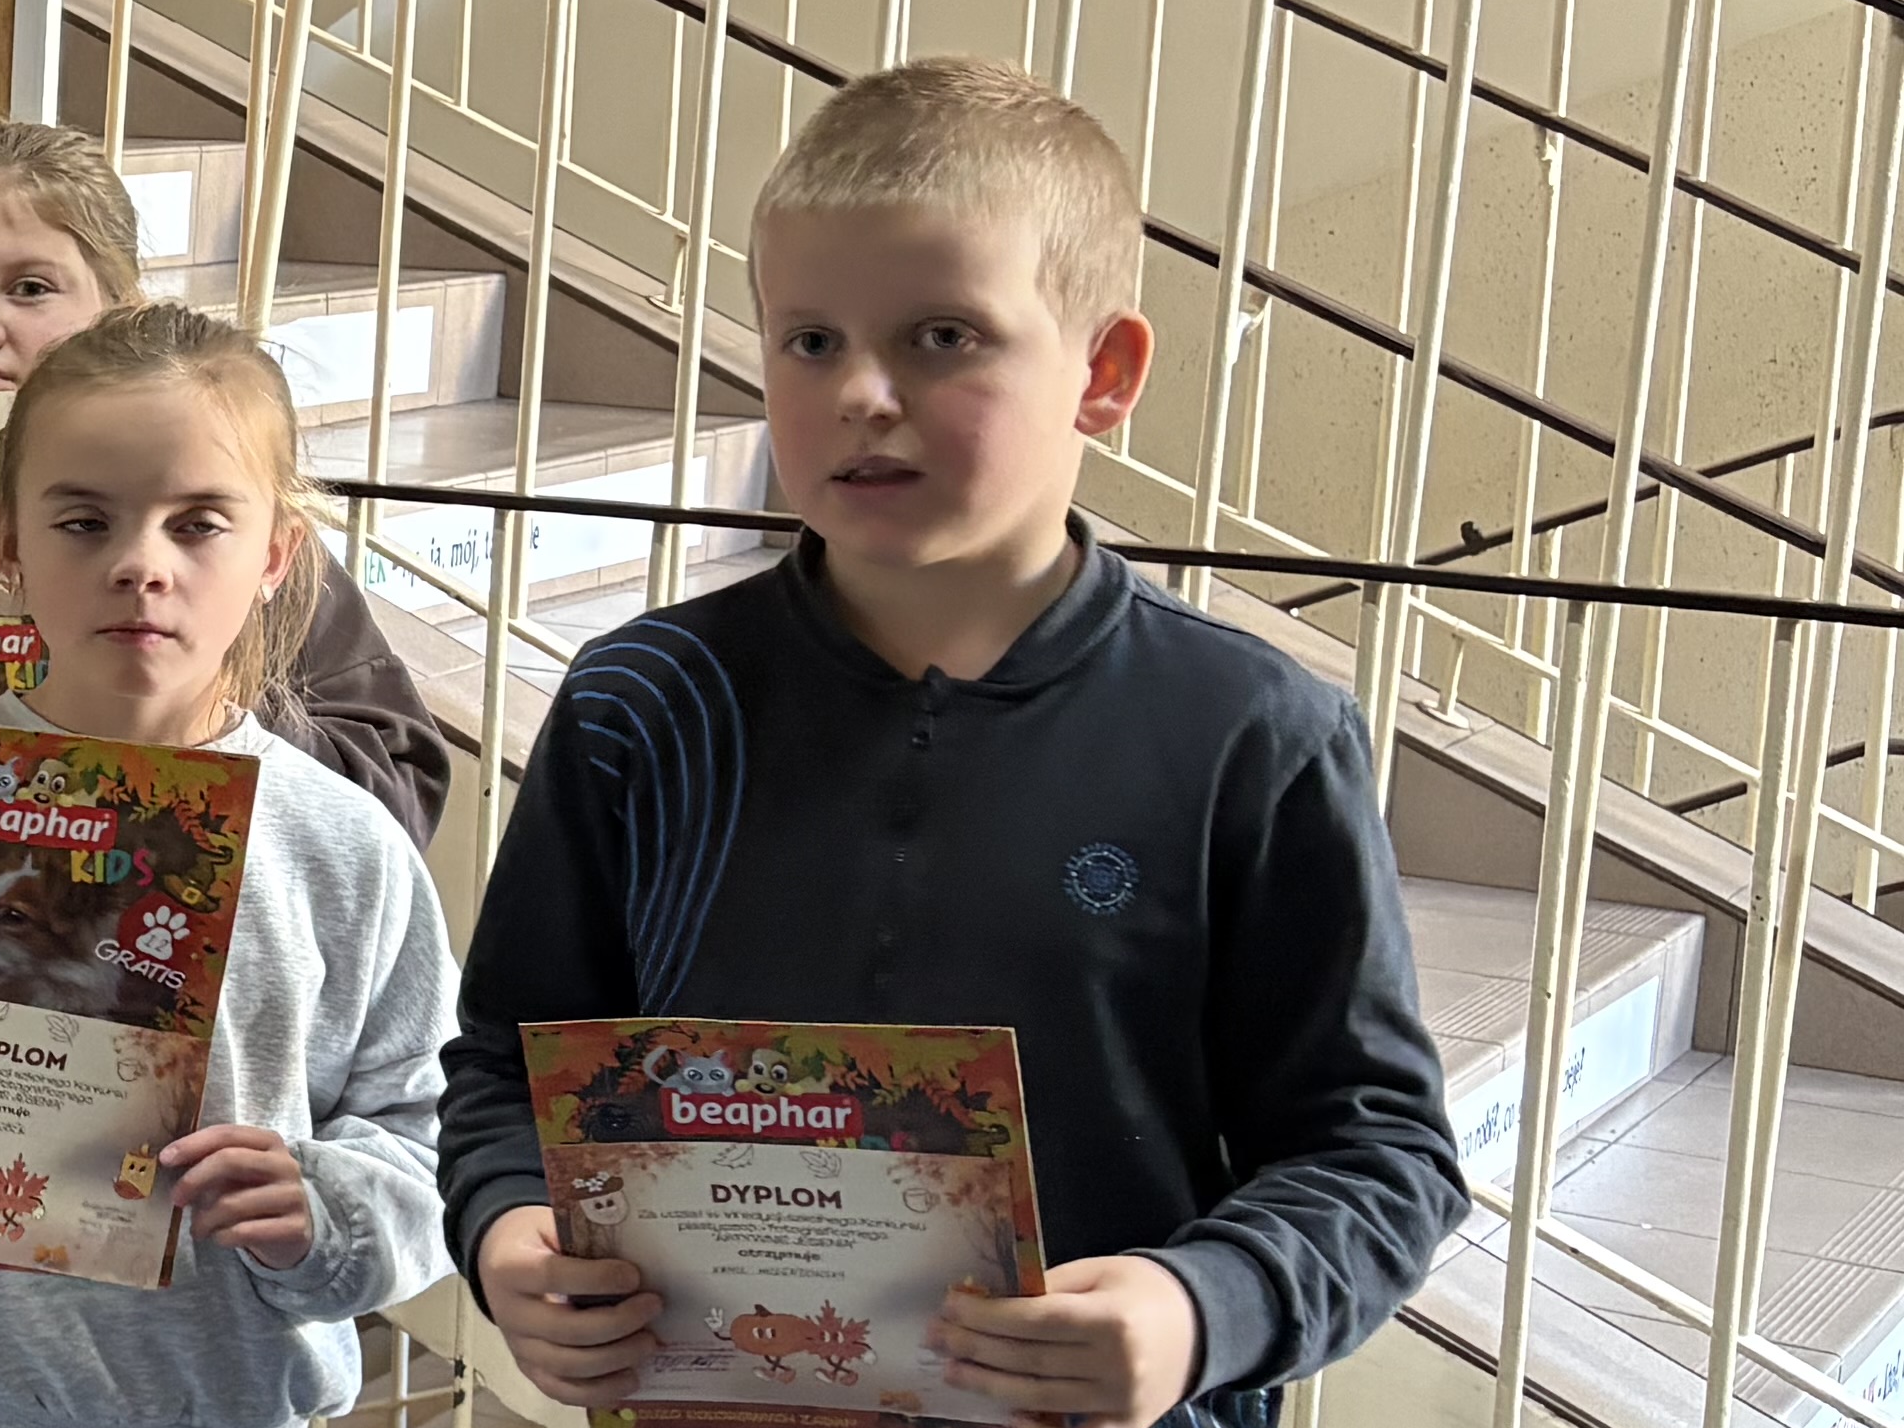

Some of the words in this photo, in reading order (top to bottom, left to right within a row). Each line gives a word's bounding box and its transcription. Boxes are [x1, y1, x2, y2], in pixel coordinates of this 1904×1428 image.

[70, 848, 153, 886] KIDS
[94, 938, 186, 991] GRATIS
[672, 1093, 852, 1130] beaphar
[711, 1184, 842, 1209] DYPLOM
